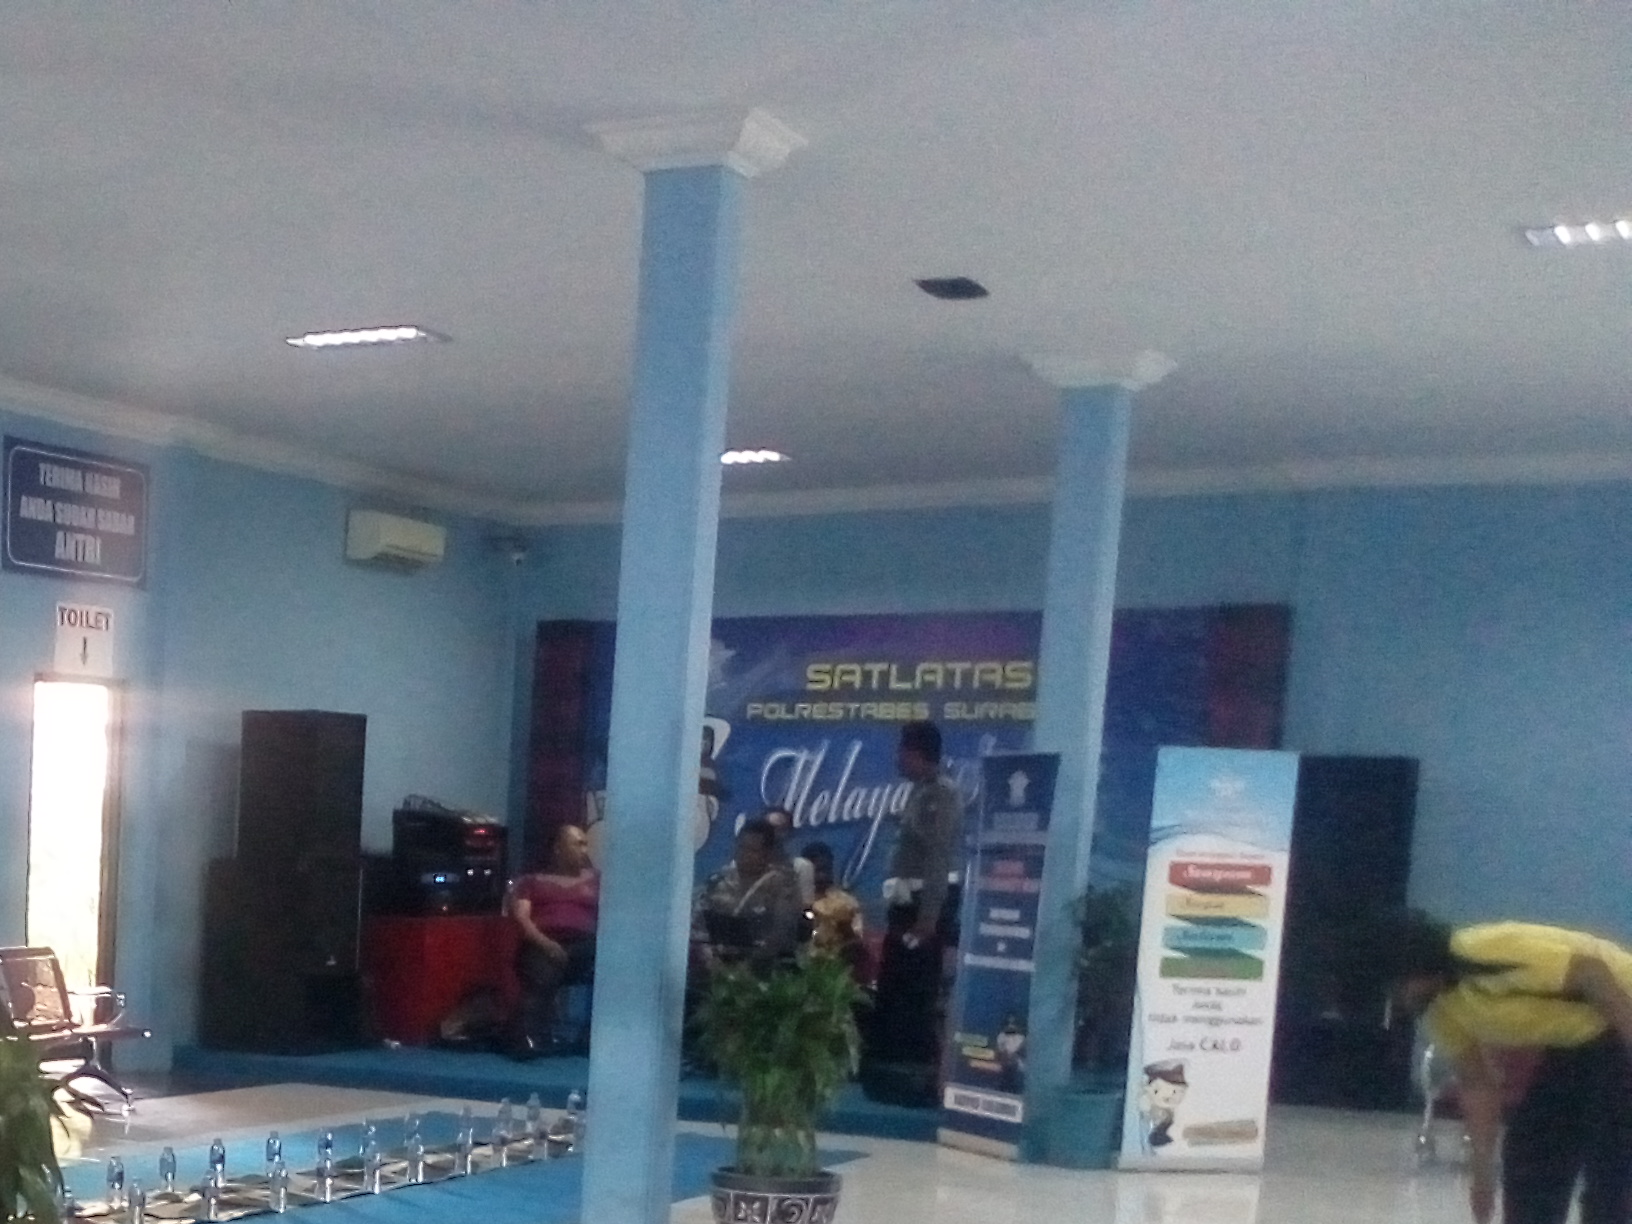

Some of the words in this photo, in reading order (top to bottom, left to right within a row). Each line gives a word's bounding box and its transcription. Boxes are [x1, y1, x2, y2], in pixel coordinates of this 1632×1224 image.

[38, 462, 83, 492] TERIMA
[85, 470, 121, 499] KASIH
[19, 494, 53, 522] ANDA
[55, 501, 95, 528] SUDAH
[97, 508, 135, 535] SABAR
[55, 530, 102, 565] ANTRI
[58, 606, 111, 630] TOILET
[806, 661, 1034, 690] SATLATAS
[746, 701, 930, 720] POLRESTABES
[944, 701, 1038, 720] SURAB
[761, 739, 915, 888] Melaya
